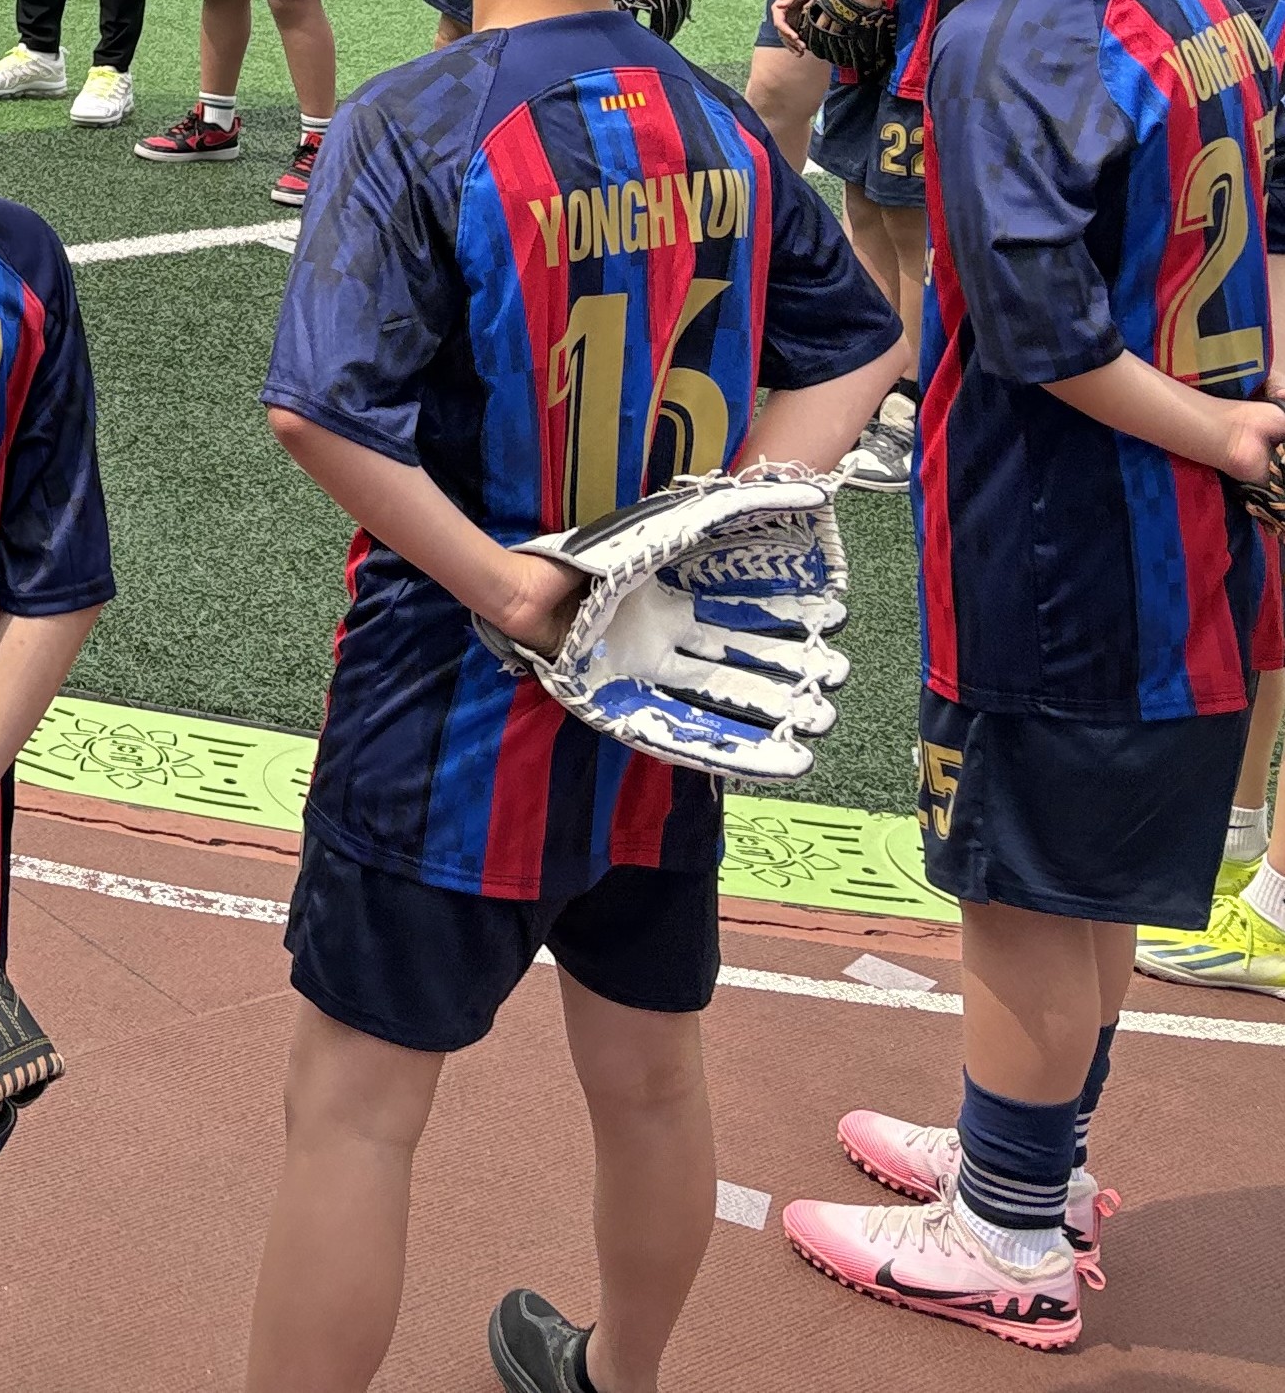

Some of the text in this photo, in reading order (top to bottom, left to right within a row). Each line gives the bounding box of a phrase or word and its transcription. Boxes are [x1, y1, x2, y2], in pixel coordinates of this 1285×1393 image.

[527, 167, 750, 269] YONGHYUN
[547, 277, 734, 531] 16
[917, 737, 964, 841] 5
